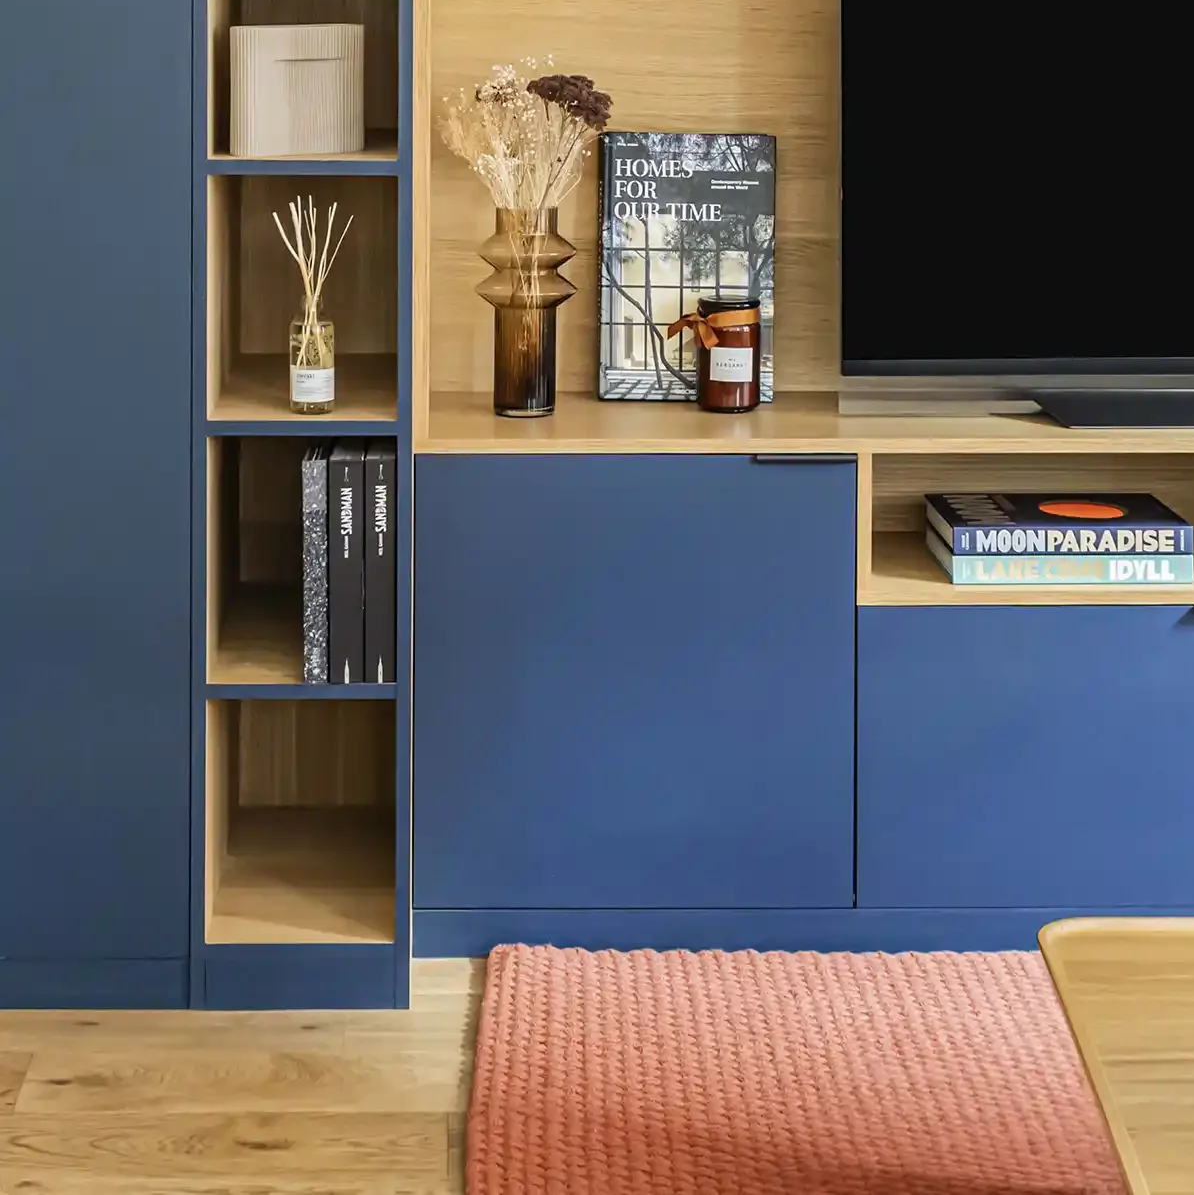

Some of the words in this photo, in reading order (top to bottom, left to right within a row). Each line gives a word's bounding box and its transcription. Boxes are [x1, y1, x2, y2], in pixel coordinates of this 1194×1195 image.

[614, 158, 693, 178] HOMES
[614, 180, 658, 199] FOR
[613, 201, 660, 221] OUR
[665, 203, 722, 222] TIME
[340, 487, 352, 535] SANDMAN
[375, 485, 387, 533] SANDMAN
[975, 559, 1040, 581] LAKE
[1109, 559, 1175, 581] IDYLL
